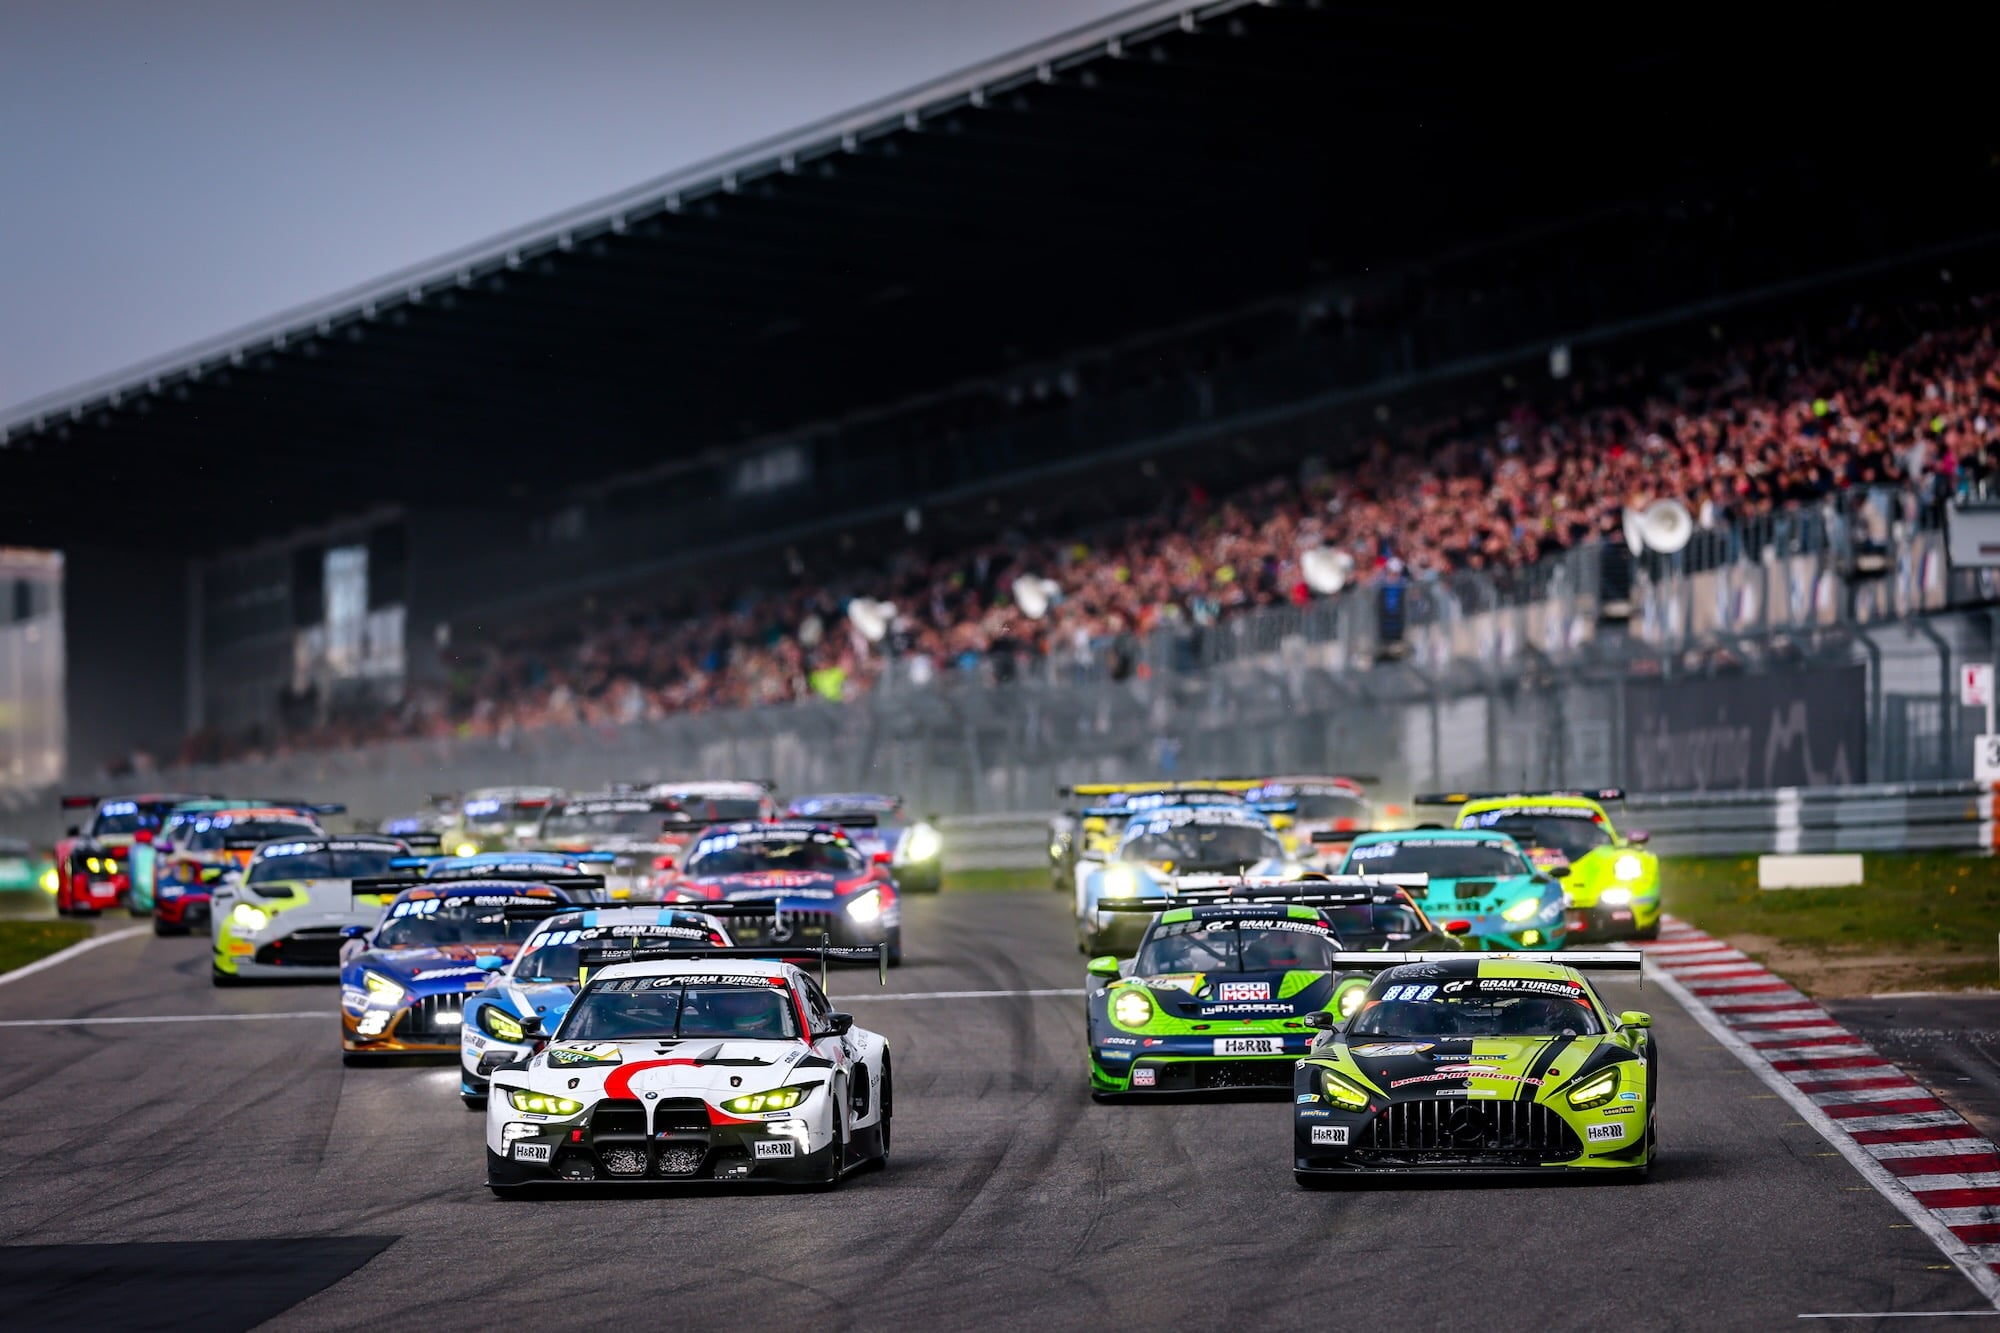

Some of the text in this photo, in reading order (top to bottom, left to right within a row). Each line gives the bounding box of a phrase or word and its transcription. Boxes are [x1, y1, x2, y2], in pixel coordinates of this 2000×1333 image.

[612, 925, 648, 935] GRAN
[650, 925, 703, 938] TURISMO
[1239, 920, 1273, 928] GRAN
[1276, 920, 1330, 935] TURISMO
[681, 975, 718, 984] GRAN
[721, 975, 773, 987] TURISM
[1222, 983, 1268, 991] LIQUI
[1479, 979, 1519, 988] GRAN
[1521, 980, 1581, 996] TURISMO
[1223, 991, 1268, 1000] MOLY
[1225, 1039, 1256, 1052] H&R
[1390, 1072, 1546, 1089] www.ck-modelcars.de
[1313, 1129, 1332, 1141] H&R
[1588, 1126, 1610, 1139] H&R
[516, 1145, 535, 1157] H&R
[757, 1143, 779, 1155] H&R
